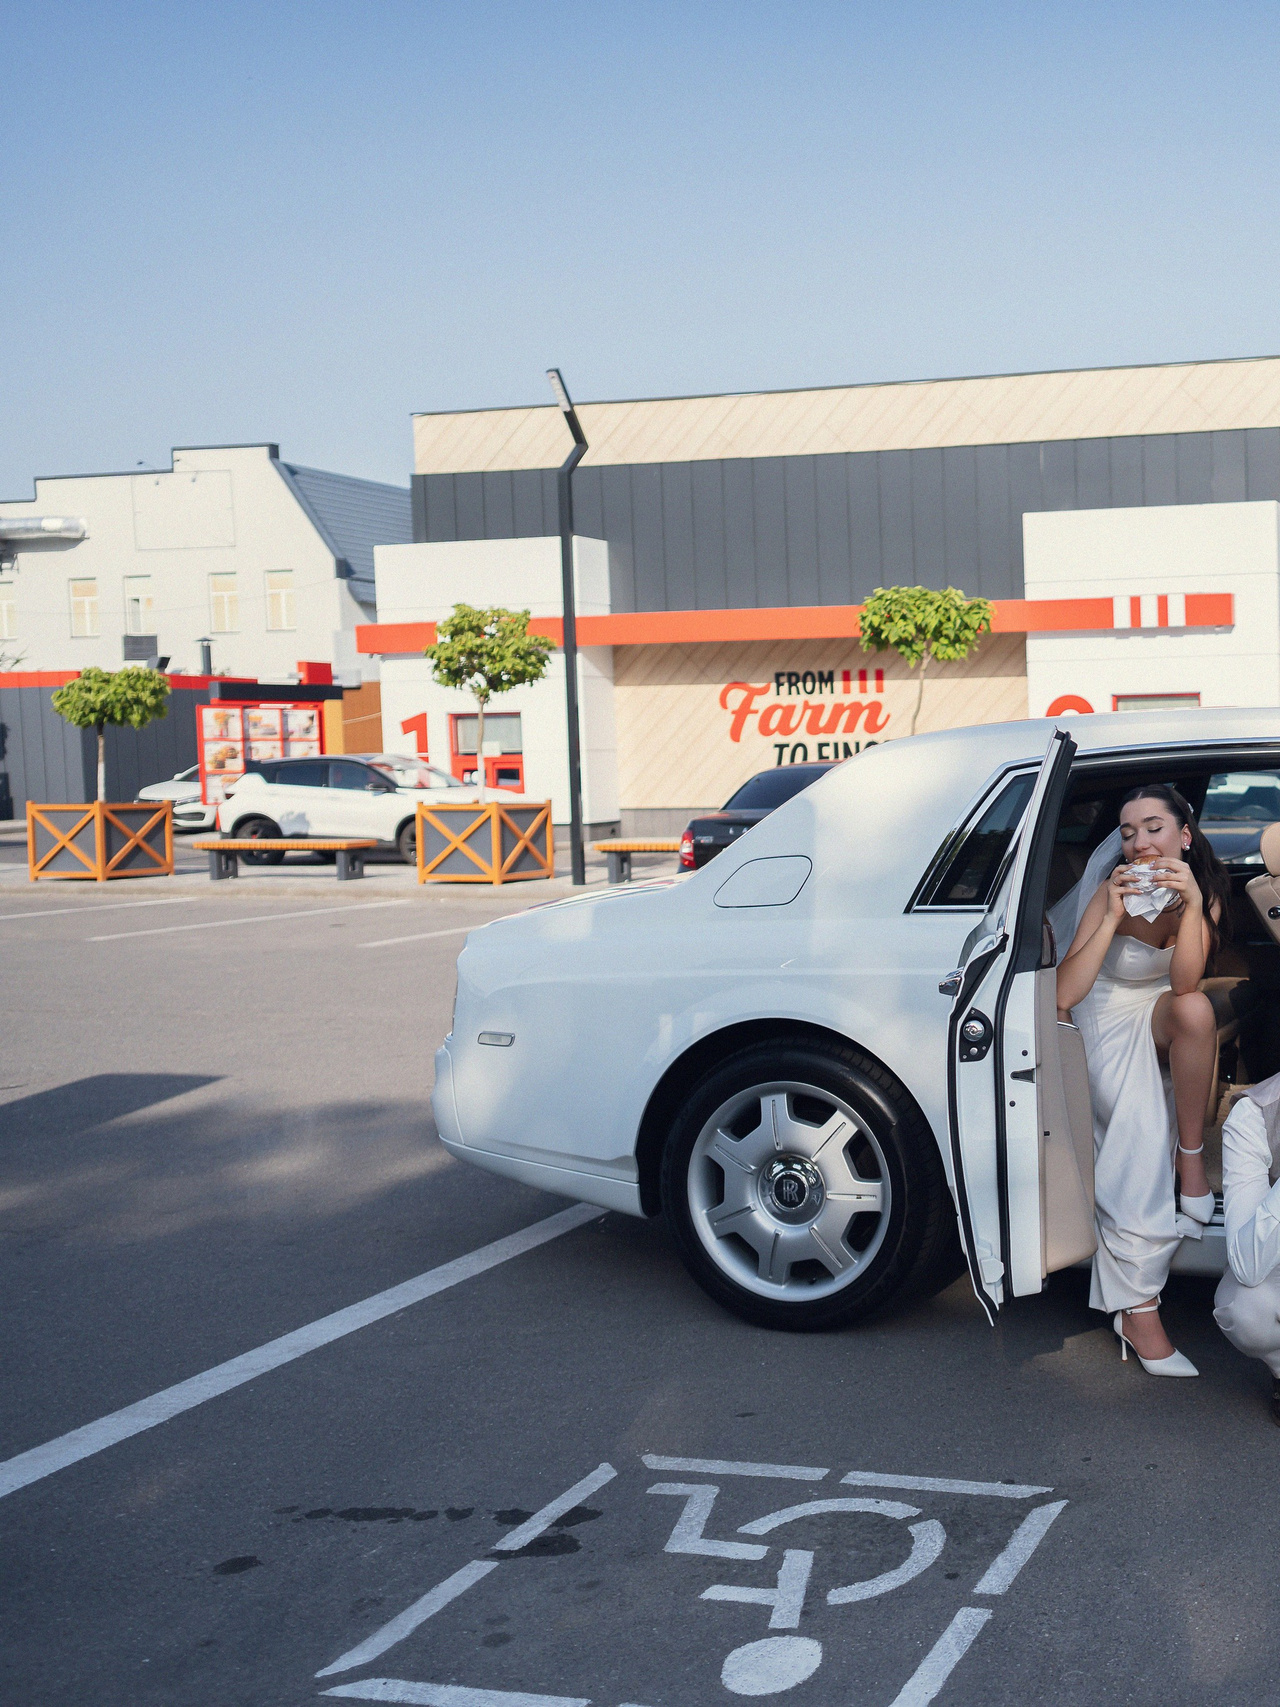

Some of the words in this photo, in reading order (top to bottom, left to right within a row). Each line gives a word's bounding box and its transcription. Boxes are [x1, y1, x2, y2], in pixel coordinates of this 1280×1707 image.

[774, 669, 835, 696] FROM
[719, 681, 892, 743] Farm
[773, 743, 809, 767] TO
